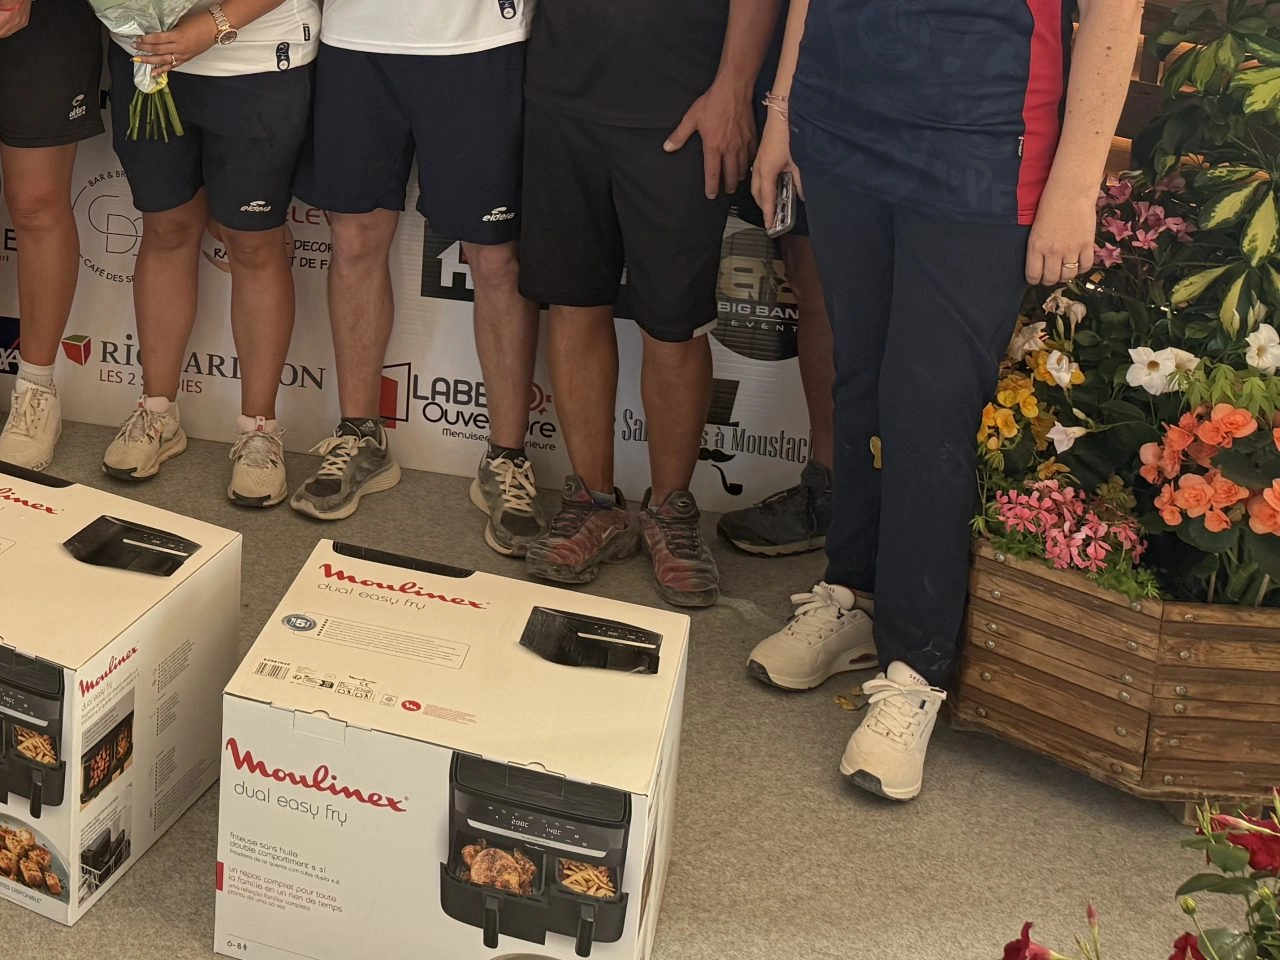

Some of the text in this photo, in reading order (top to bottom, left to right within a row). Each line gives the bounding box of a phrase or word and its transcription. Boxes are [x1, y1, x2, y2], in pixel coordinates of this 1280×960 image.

[88, 173, 106, 187] BAR
[482, 210, 515, 222] eldera
[83, 258, 105, 277] CAFÉ
[106, 272, 124, 283] DES
[717, 302, 799, 320] BIG BAN
[99, 369, 123, 384] LES
[127, 373, 136, 385] 2
[317, 583, 427, 612] dual easy fry
[319, 563, 488, 610] Moulinex
[78, 647, 138, 698] Moulinex
[226, 737, 407, 812] Moulinex
[234, 781, 347, 827] dual easy fry
[229, 832, 298, 858] friteuse sans huile
[229, 841, 308, 870] double compartiment
[228, 874, 343, 913] la famille en un rien de temps
[229, 866, 337, 903] un repas complet pour toute
[226, 940, 241, 950] 6-8
